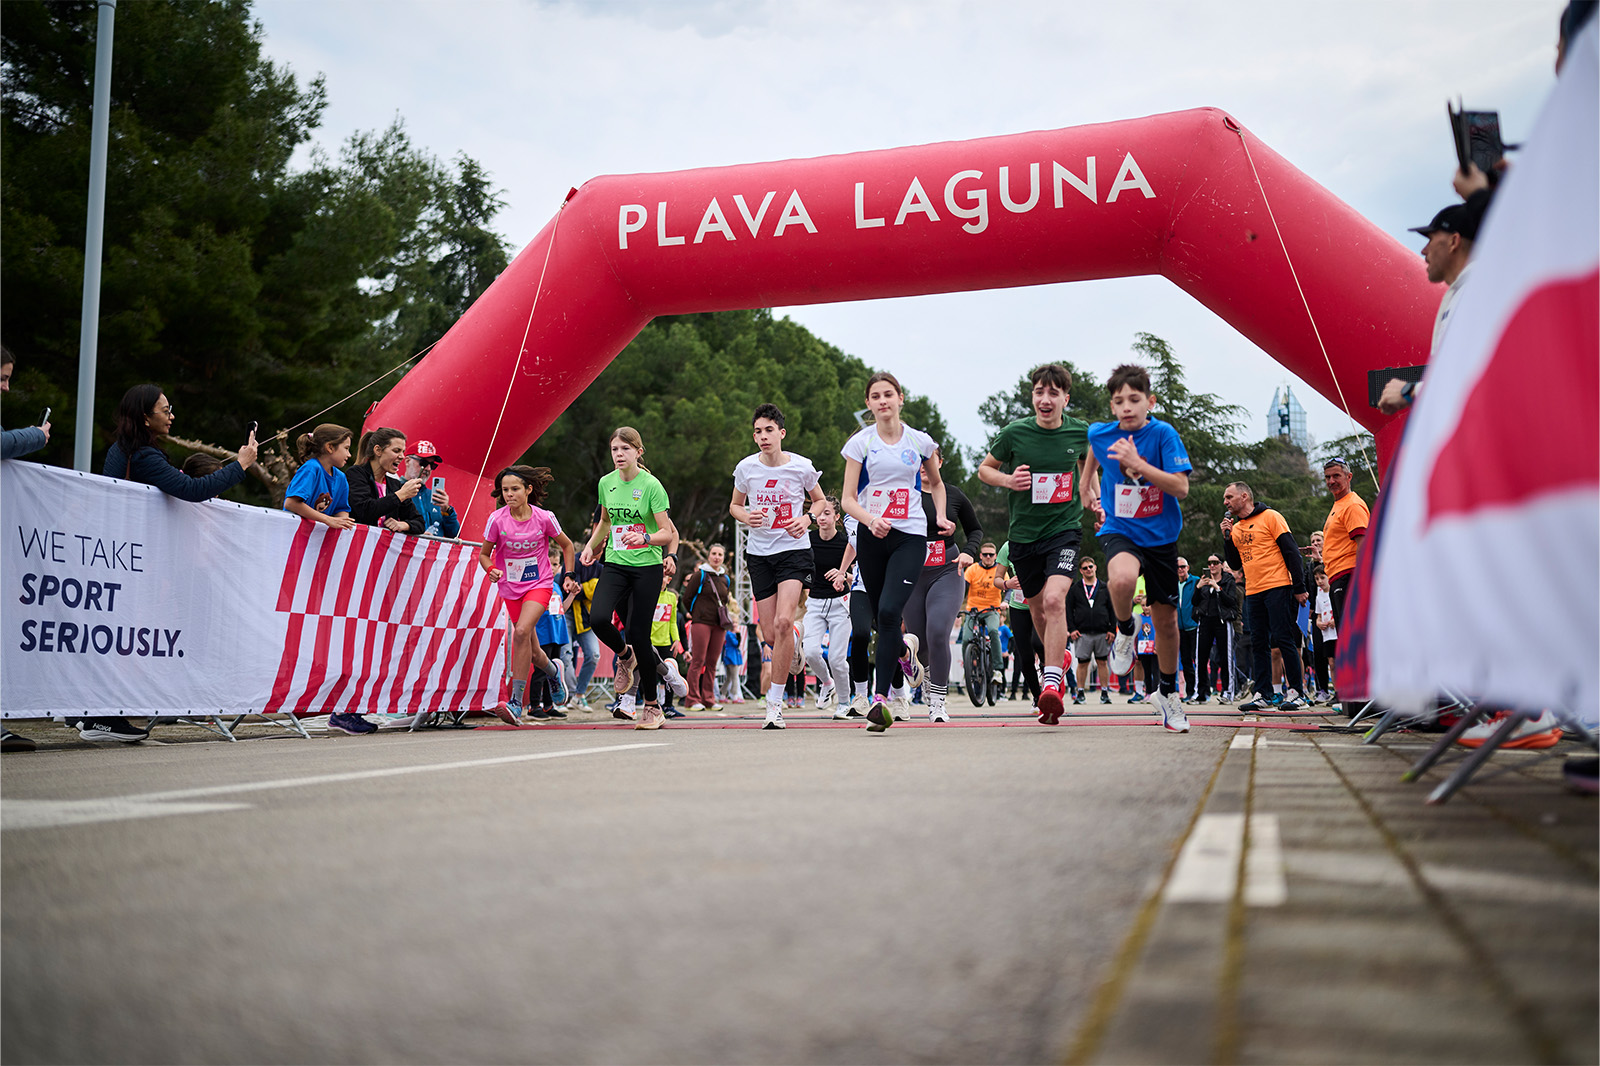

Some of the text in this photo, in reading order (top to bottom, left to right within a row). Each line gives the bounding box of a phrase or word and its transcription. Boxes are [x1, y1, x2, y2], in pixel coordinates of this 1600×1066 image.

[618, 151, 1157, 250] PLAVA LAGUNA
[757, 494, 784, 503] HALF
[1057, 491, 1070, 499] 4156
[1143, 504, 1160, 512] 4164
[608, 508, 643, 520] STRA
[19, 525, 144, 573] WE TAKE
[1057, 561, 1075, 571] NIKE
[524, 571, 537, 579] 3133
[19, 573, 122, 612] SPORT
[20, 619, 185, 659] SERIOUSLY.
[93, 722, 112, 732] HOKA
